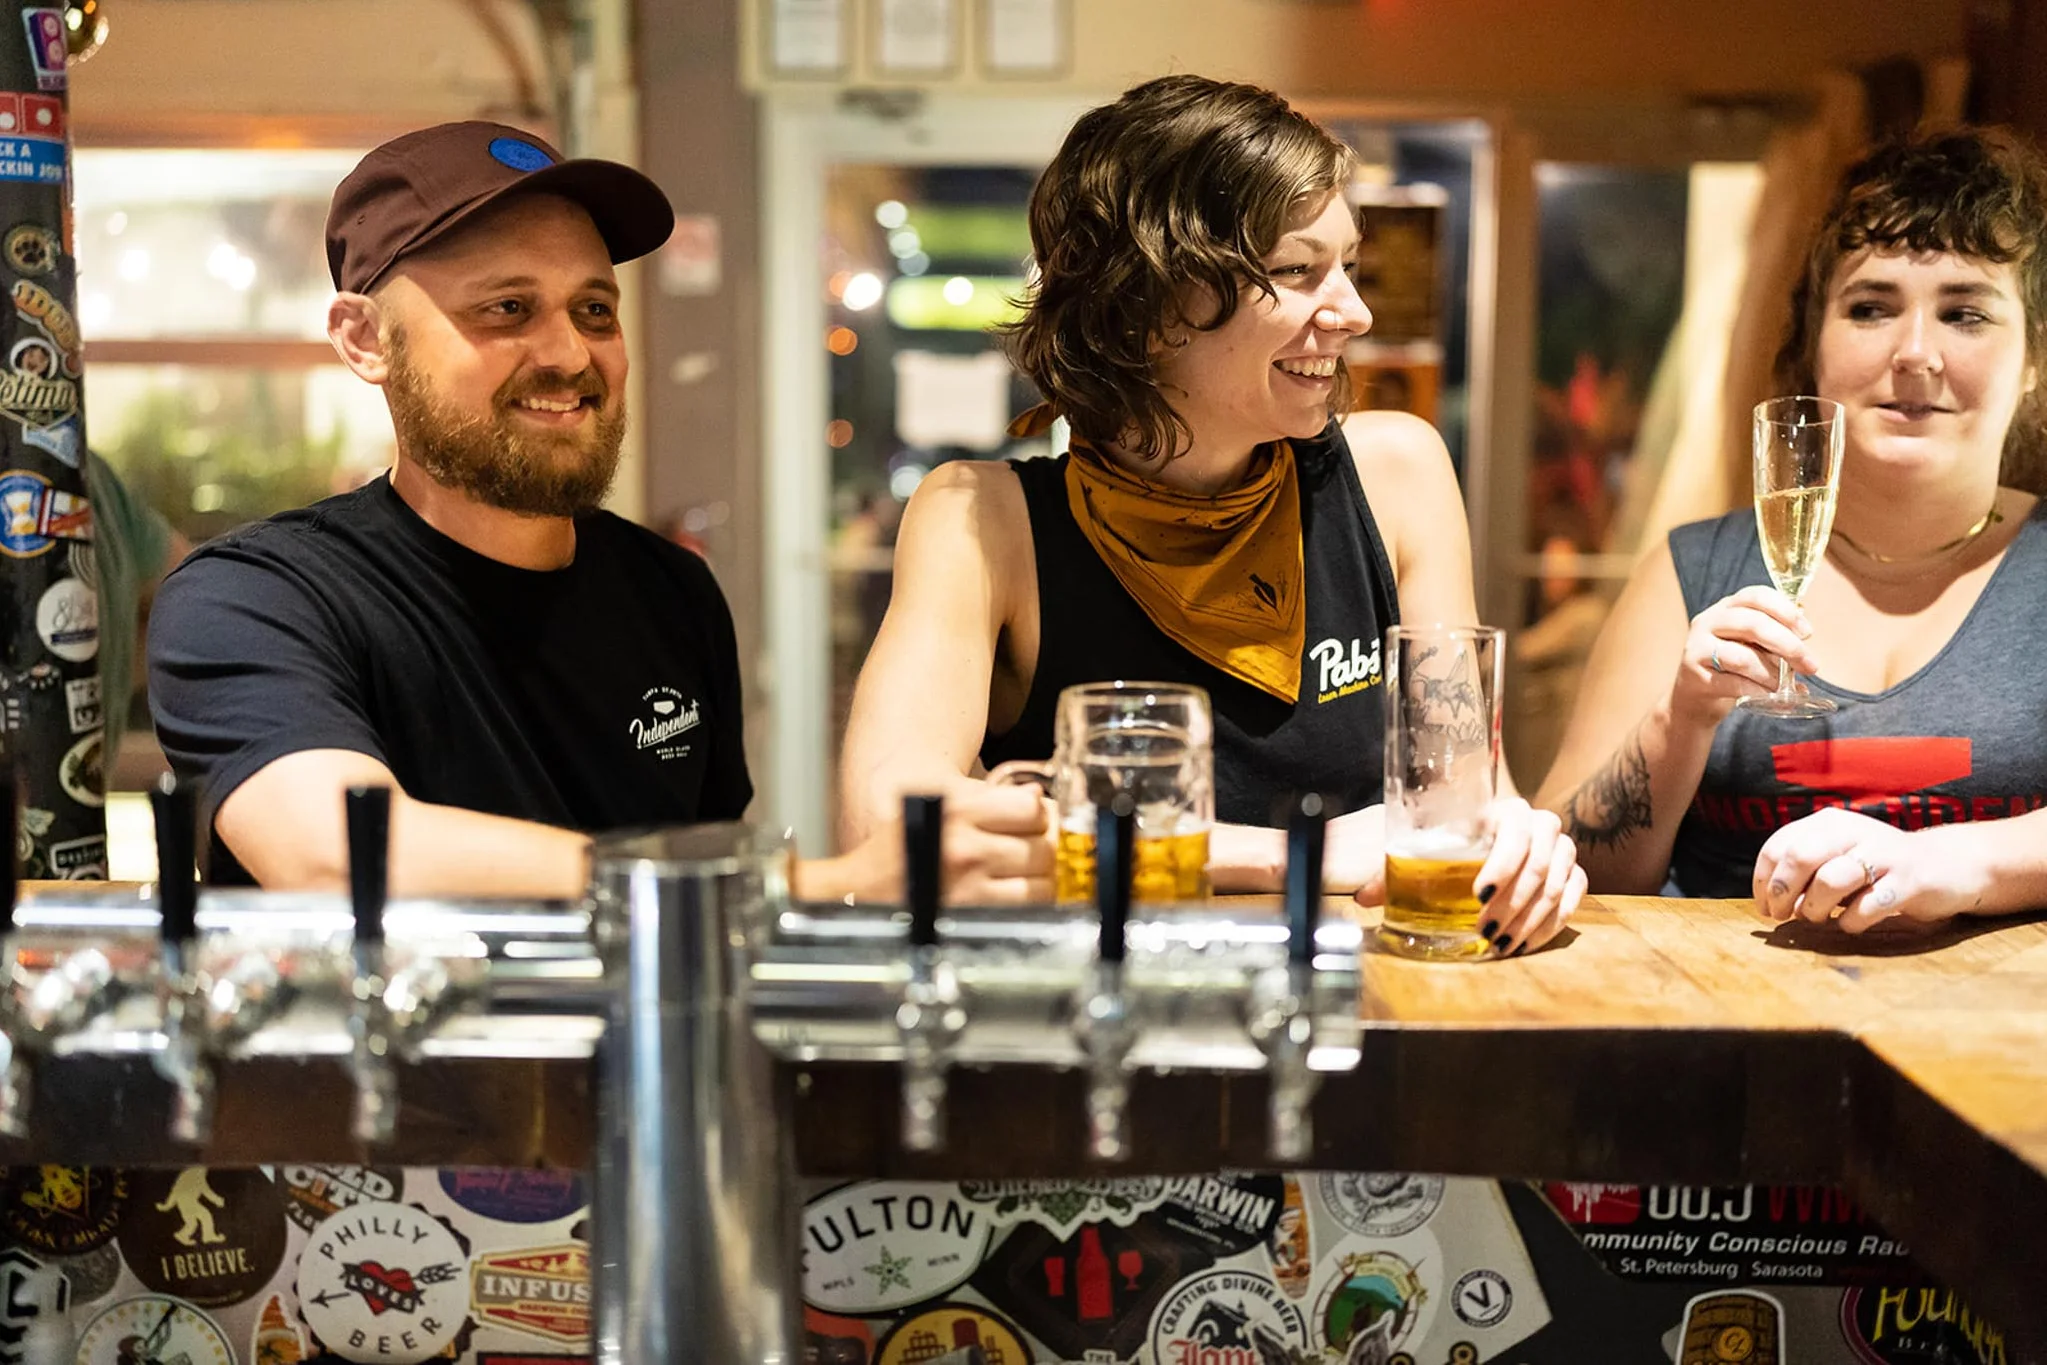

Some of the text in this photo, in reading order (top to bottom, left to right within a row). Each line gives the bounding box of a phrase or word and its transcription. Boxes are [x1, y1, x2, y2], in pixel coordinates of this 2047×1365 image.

[1309, 637, 1381, 692] Pabs
[319, 1216, 429, 1261] PHILLY
[1708, 1231, 1848, 1256] Conscious
[161, 1247, 255, 1281] I BELIEVE.
[1620, 1257, 1823, 1280] St. Petersburg Sarasota
[1162, 1276, 1299, 1336] CRAFTING DIVINE BEER
[348, 1315, 443, 1355] BEER
